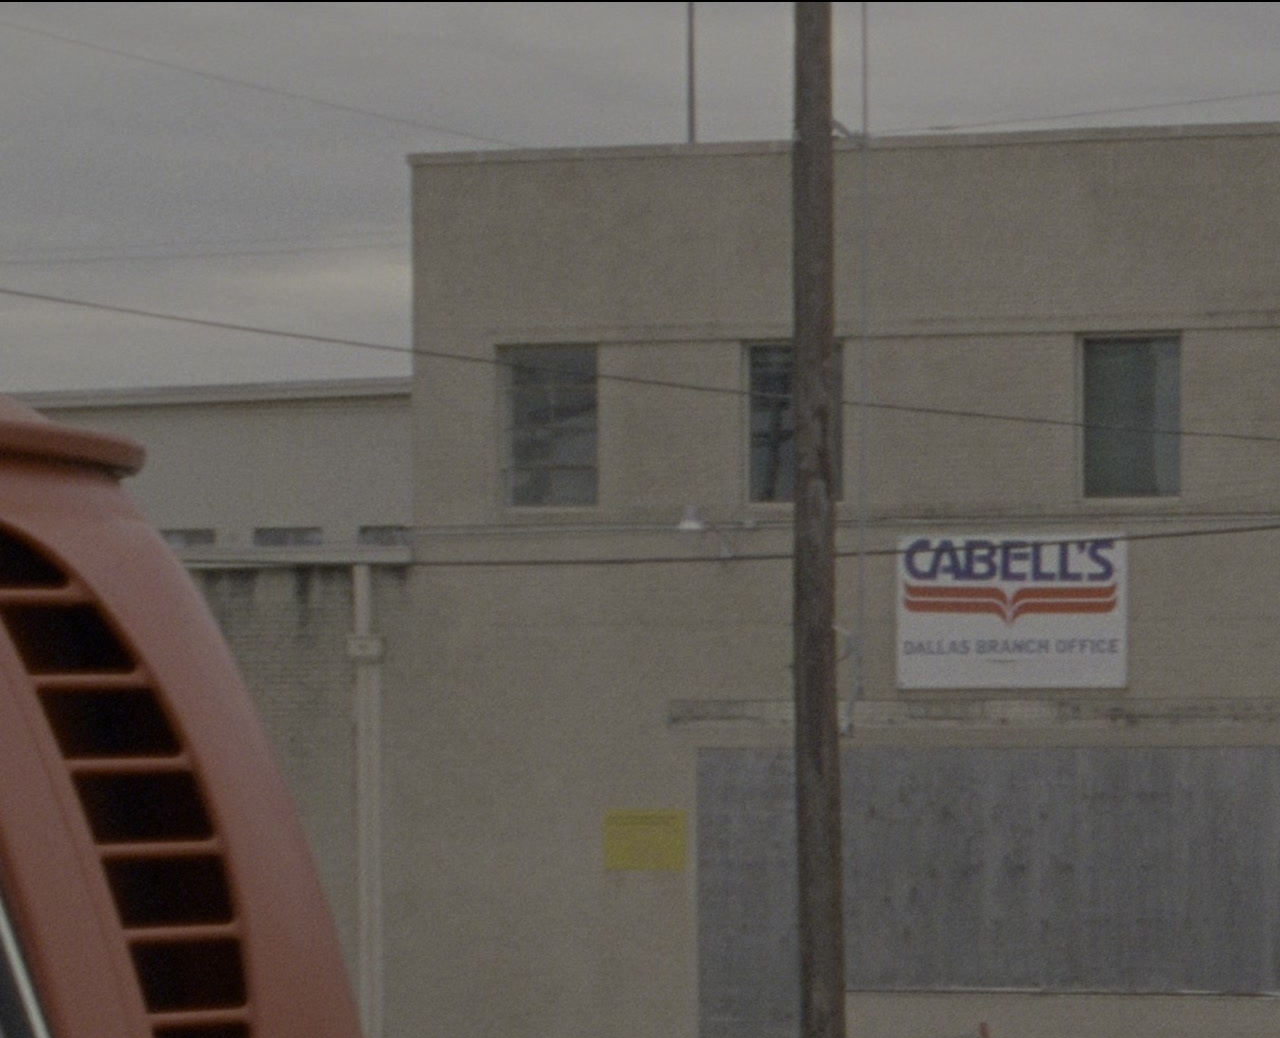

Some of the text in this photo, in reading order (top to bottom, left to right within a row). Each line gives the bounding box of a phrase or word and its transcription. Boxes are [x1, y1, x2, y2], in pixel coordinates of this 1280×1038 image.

[903, 538, 1115, 581] CABELL'S
[904, 638, 1118, 655] DALLAS BRANCH OFFICE
